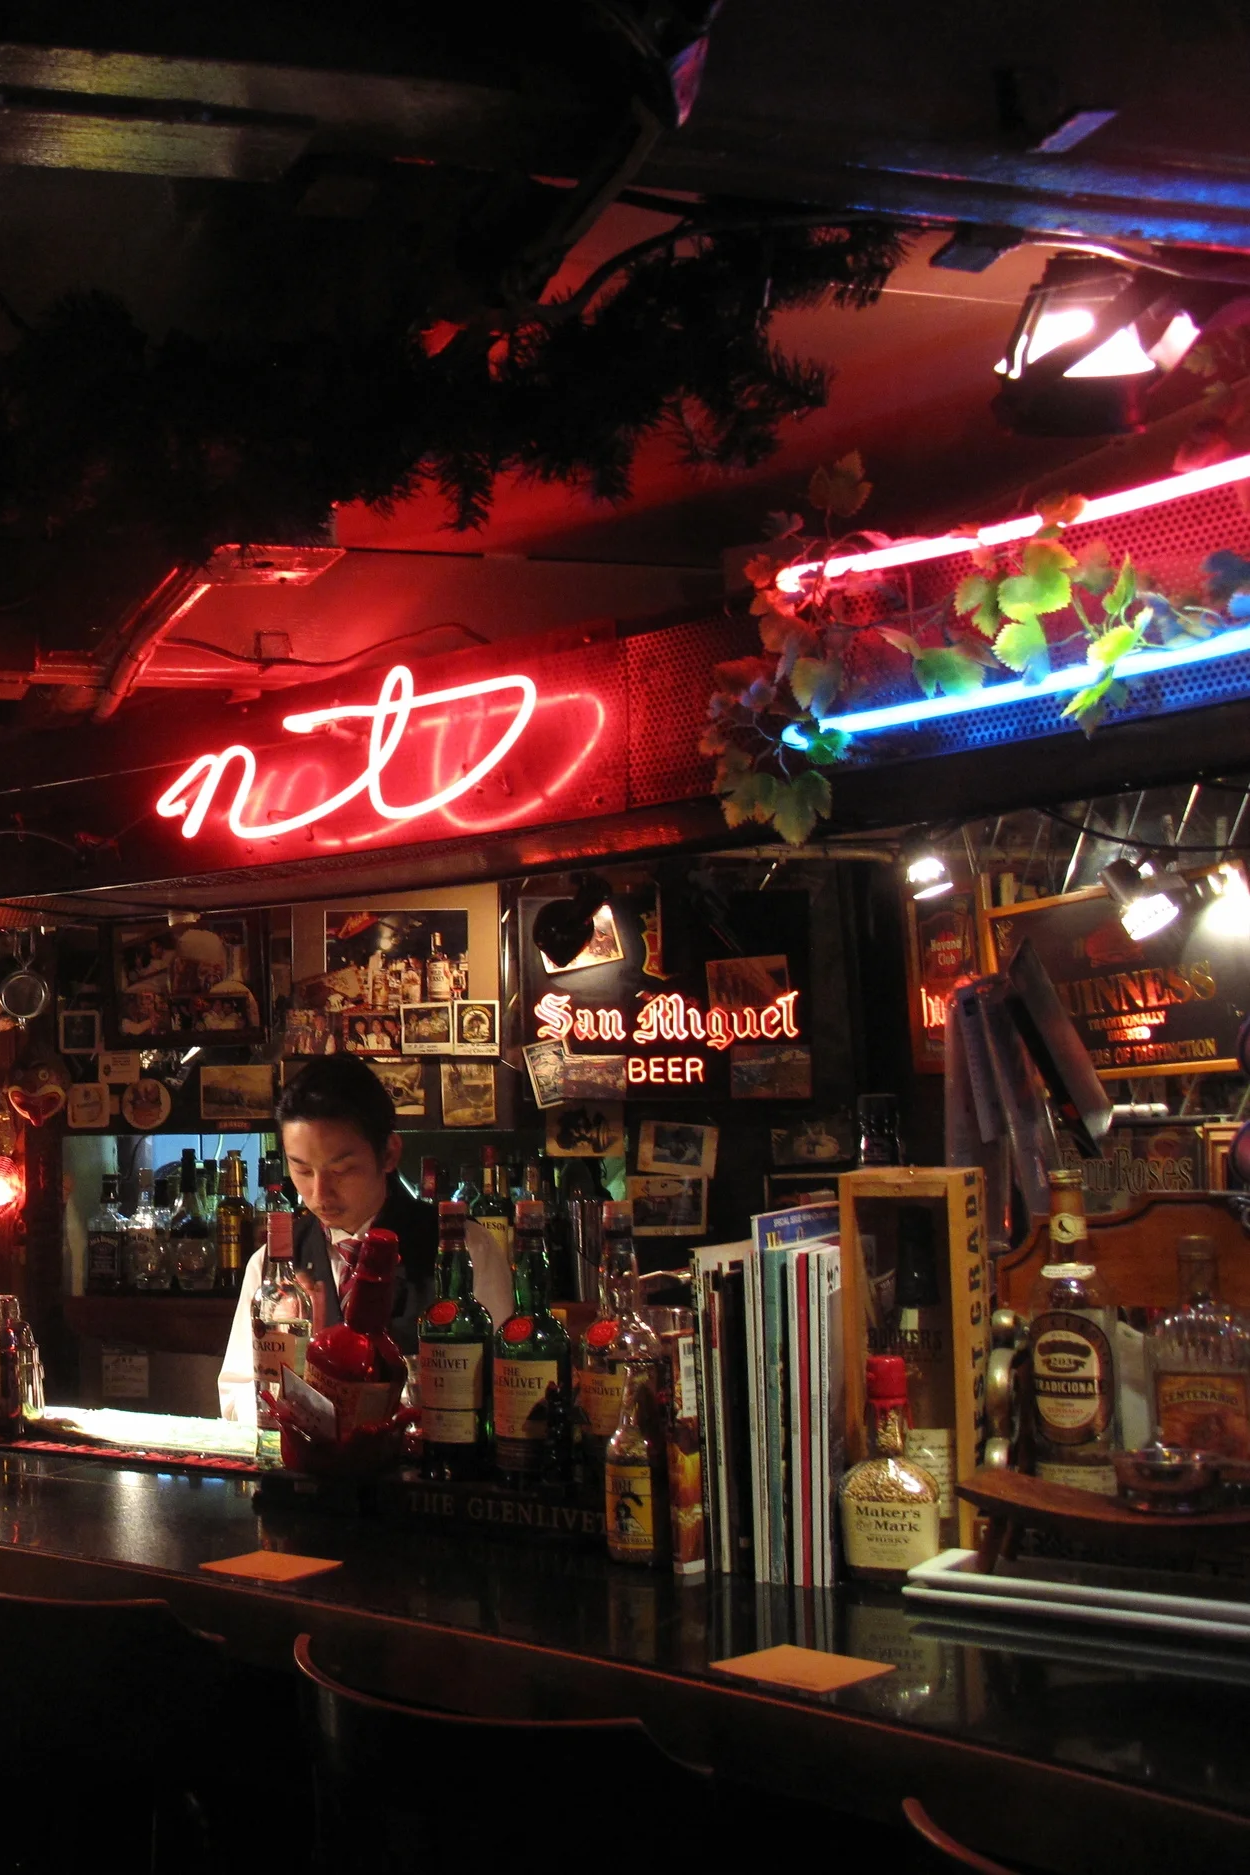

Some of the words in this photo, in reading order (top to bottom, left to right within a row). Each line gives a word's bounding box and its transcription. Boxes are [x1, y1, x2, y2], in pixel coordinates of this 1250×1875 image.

[1057, 960, 1217, 1017] UINNESS
[533, 993, 627, 1041] San
[632, 990, 800, 1051] Miguel
[627, 1056, 704, 1084] BEER
[965, 1171, 982, 1327] GRADE
[407, 1491, 456, 1516] THE
[466, 1496, 607, 1535] GLENLIVET
[855, 1505, 921, 1519] Maker's
[874, 1519, 921, 1532] Mark
